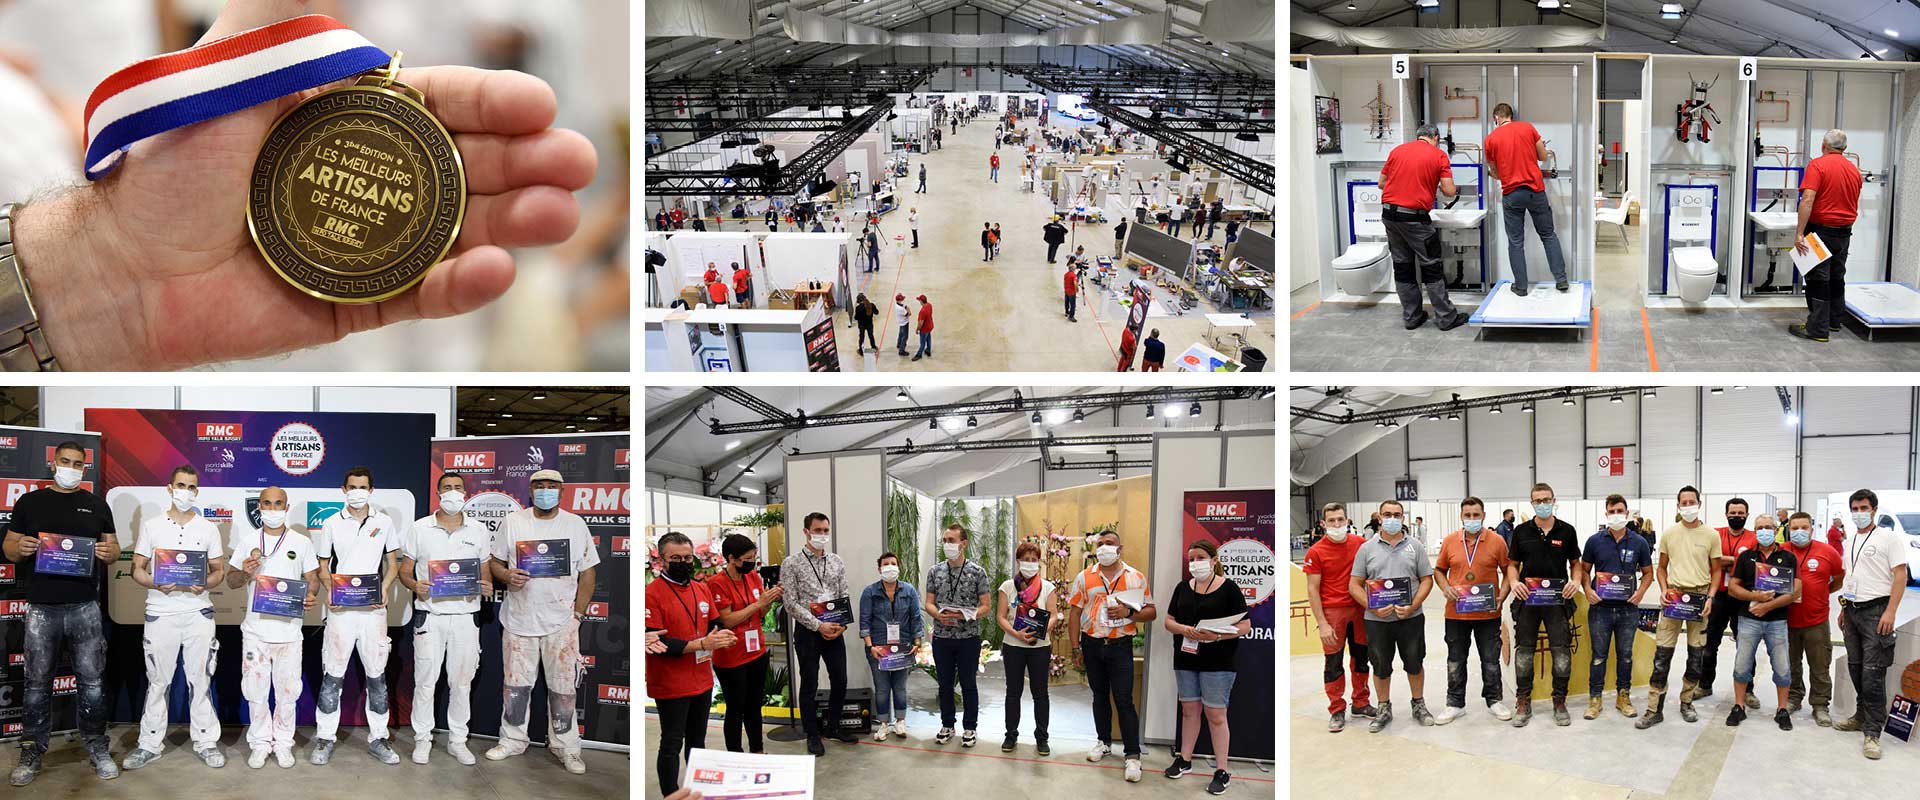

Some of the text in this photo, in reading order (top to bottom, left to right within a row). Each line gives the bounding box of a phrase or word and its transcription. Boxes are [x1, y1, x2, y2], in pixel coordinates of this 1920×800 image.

[1396, 60, 1405, 74] 5
[1743, 62, 1753, 77] 6
[360, 146, 394, 162] ÉDITION
[315, 145, 412, 187] LES MEILLEURS
[298, 162, 414, 213] ARTISANS
[310, 190, 388, 226] DE FRANCE
[324, 217, 360, 238] RMC
[206, 425, 235, 436] RMC
[274, 443, 321, 451] ARTISANS
[453, 454, 486, 467] RMC
[506, 463, 542, 471] worldskills
[1206, 504, 1238, 516] RMC
[1230, 555, 1271, 563] MEILLEURS
[1223, 565, 1275, 576] RTISANS
[9, 602, 31, 613] RM
[608, 687, 630, 699] RM
